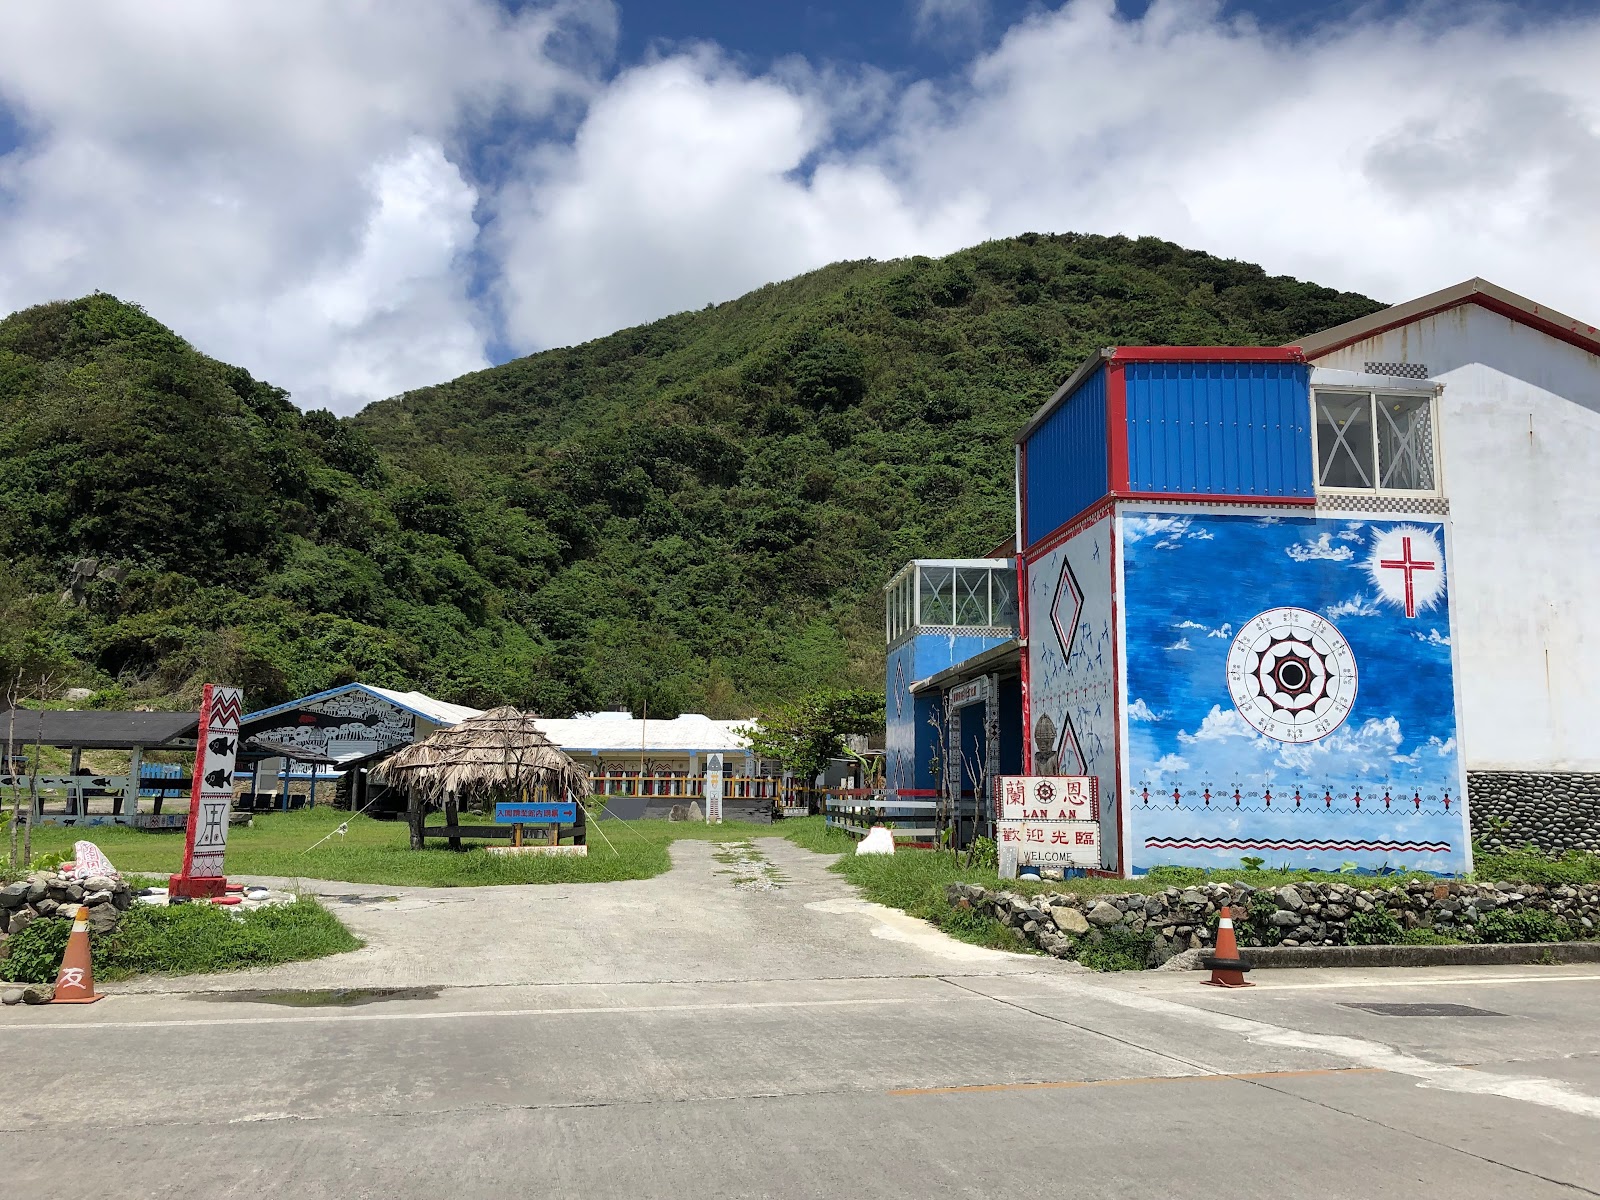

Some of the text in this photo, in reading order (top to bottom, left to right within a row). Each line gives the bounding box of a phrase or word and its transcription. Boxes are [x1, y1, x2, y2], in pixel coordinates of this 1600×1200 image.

[1006, 780, 1088, 806] 蘭 恩
[1022, 809, 1077, 818] LAN AN
[1002, 827, 1095, 846] 歡迎光臨
[1023, 851, 1072, 862] WELCOME
